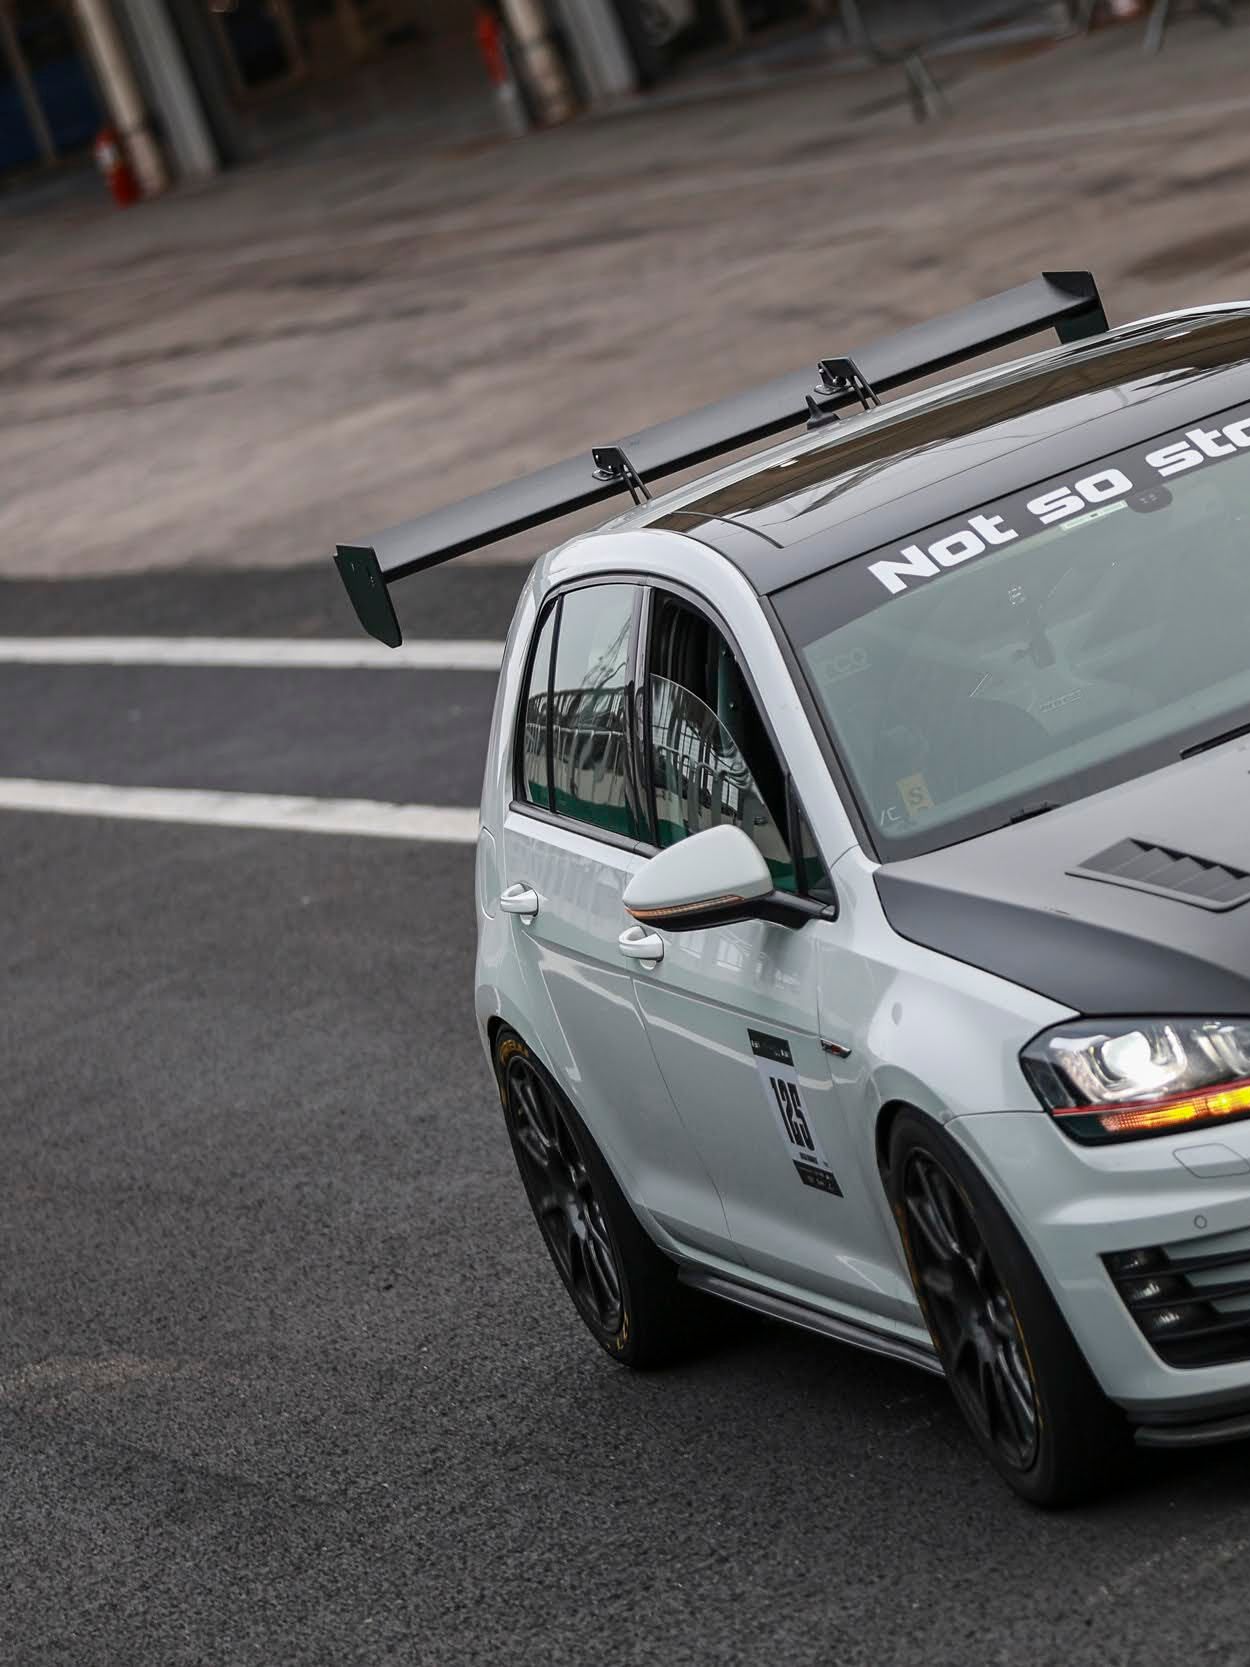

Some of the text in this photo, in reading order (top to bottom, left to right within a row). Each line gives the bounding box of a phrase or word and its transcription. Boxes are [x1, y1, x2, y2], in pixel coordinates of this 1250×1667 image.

[868, 514, 1019, 594] Not
[1027, 469, 1132, 525] so
[769, 1077, 815, 1151] 125
